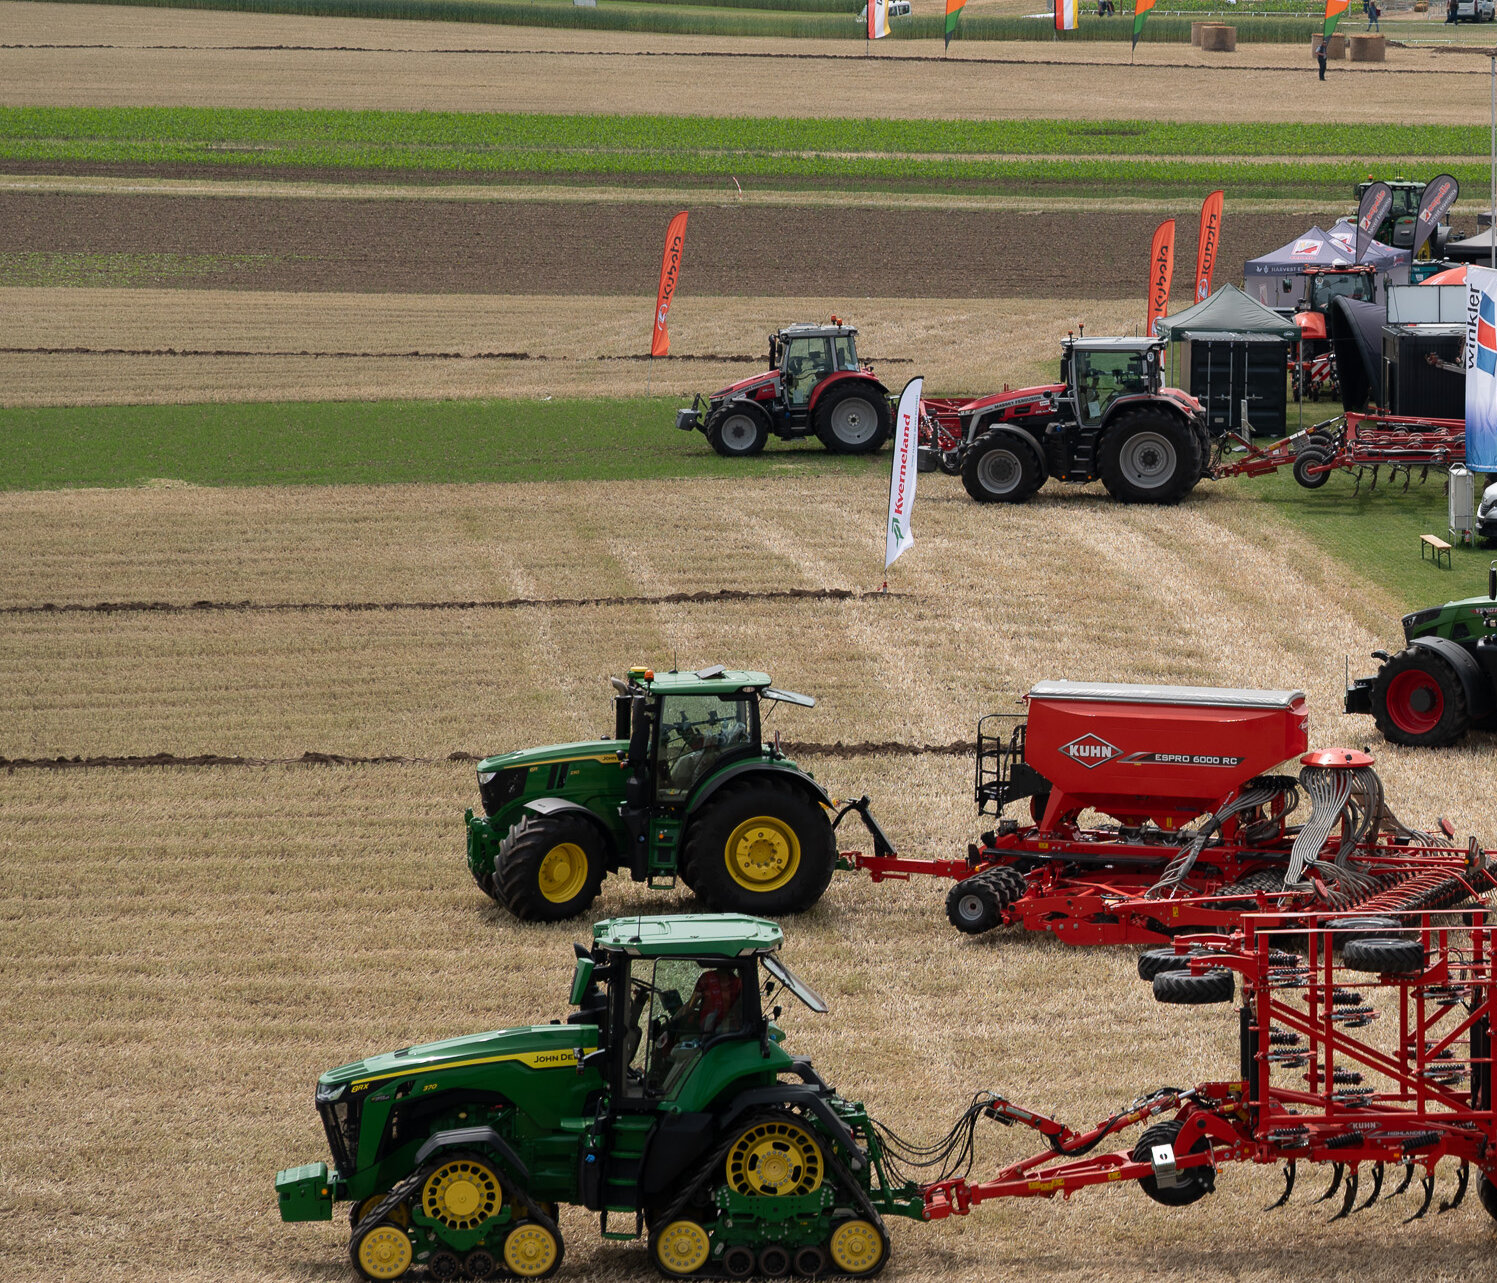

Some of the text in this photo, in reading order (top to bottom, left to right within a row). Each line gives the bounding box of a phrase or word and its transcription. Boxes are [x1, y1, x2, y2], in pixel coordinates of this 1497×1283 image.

[1202, 213, 1217, 275] Kubota
[662, 236, 682, 301] Kubota
[1154, 246, 1170, 313] Kubota
[1467, 284, 1481, 370] winkler
[894, 414, 911, 515] Kverneland
[1069, 744, 1112, 759] KUHN
[1155, 753, 1238, 765] ESPRO 6000 RC
[533, 1054, 558, 1065] JOHN
[351, 1082, 370, 1094] 8RX
[423, 1083, 438, 1092] 370
